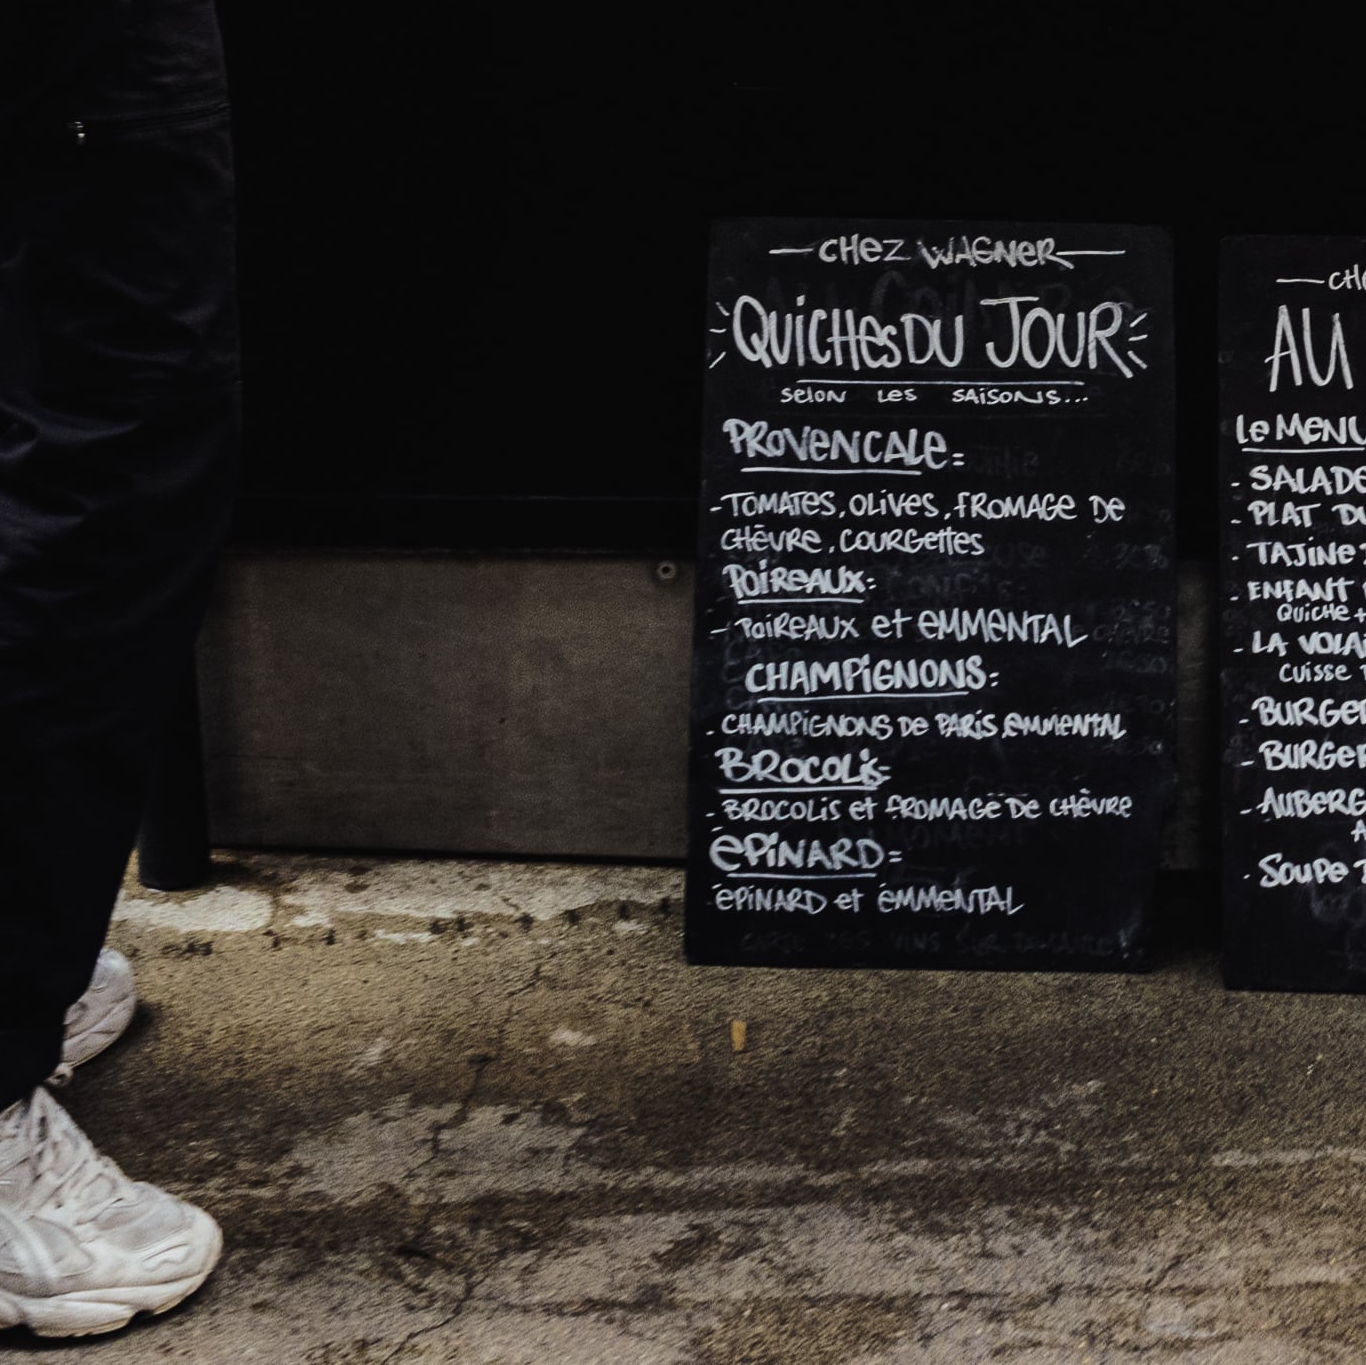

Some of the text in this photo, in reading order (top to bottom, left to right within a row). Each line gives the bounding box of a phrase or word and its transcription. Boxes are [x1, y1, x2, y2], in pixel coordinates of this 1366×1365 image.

[901, 312, 964, 370] DU
[980, 296, 1134, 379] JOUR
[1264, 304, 1354, 393] AU
[1247, 500, 1323, 528] PLAT
[1251, 630, 1289, 657] LA
